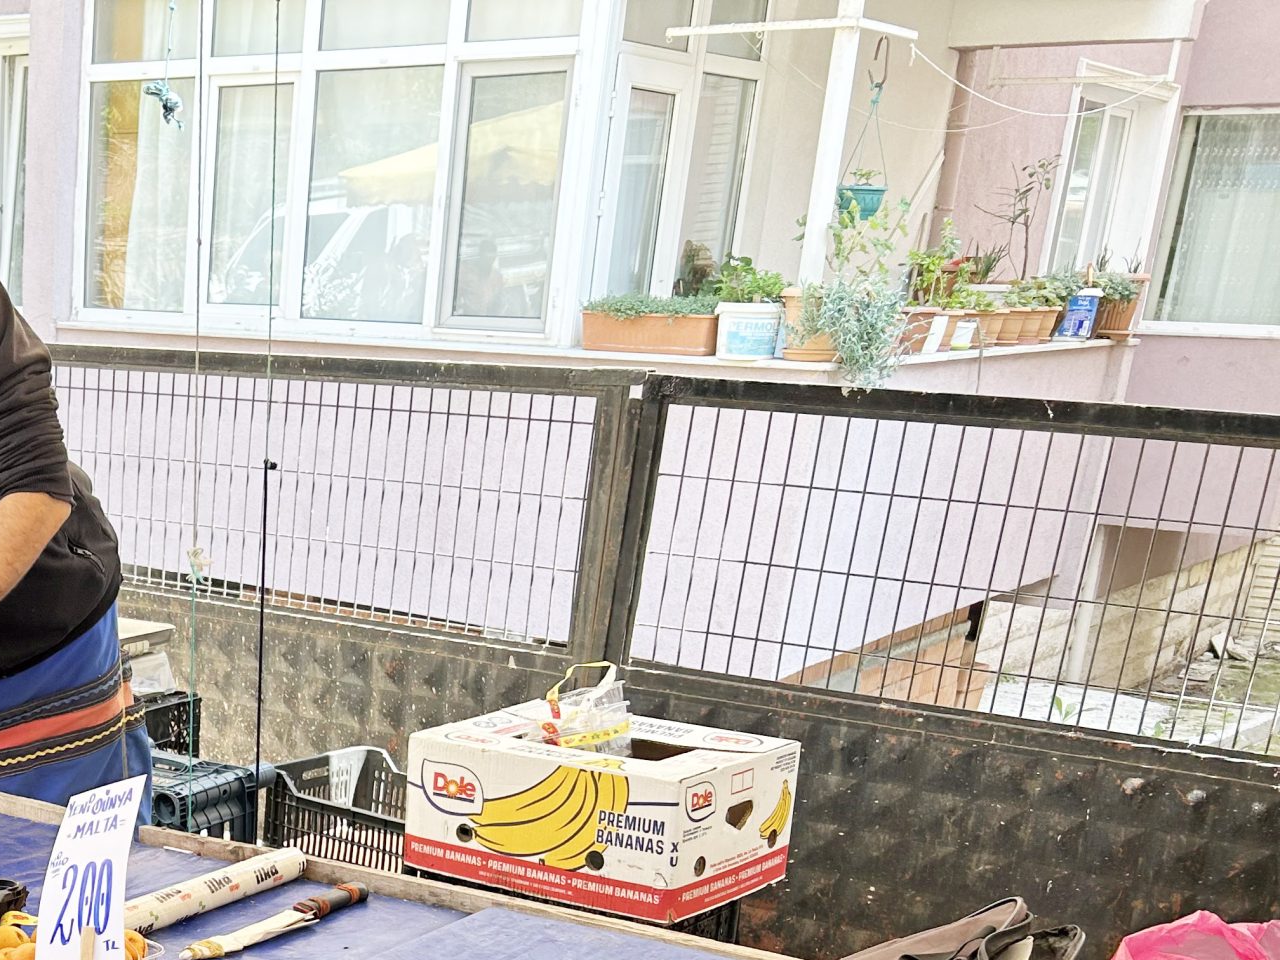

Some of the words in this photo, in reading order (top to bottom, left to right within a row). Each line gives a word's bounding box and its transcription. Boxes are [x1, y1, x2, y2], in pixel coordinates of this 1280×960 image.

[631, 726, 686, 739] PREMIU
[432, 771, 477, 798] Dole
[691, 788, 713, 809] Dole
[598, 810, 665, 836] PREMIUM
[596, 829, 664, 855] BANANAS
[670, 841, 679, 853] X
[669, 856, 679, 867] U
[253, 864, 280, 885] ilka
[410, 841, 444, 858] PREMIUM
[445, 849, 482, 867] BANANAS
[487, 859, 525, 876] PREMIUM
[526, 867, 567, 885] BANANAS
[572, 878, 613, 895] PREMIUM
[614, 886, 660, 905] BANANAS
[681, 884, 710, 902] PREMIUM
[709, 874, 736, 892] BANANAS
[738, 863, 761, 881] PREMIUM
[761, 853, 783, 871] BANANAS
[203, 875, 233, 895] ilka
[49, 858, 113, 946] 200
[103, 939, 120, 951] TL
